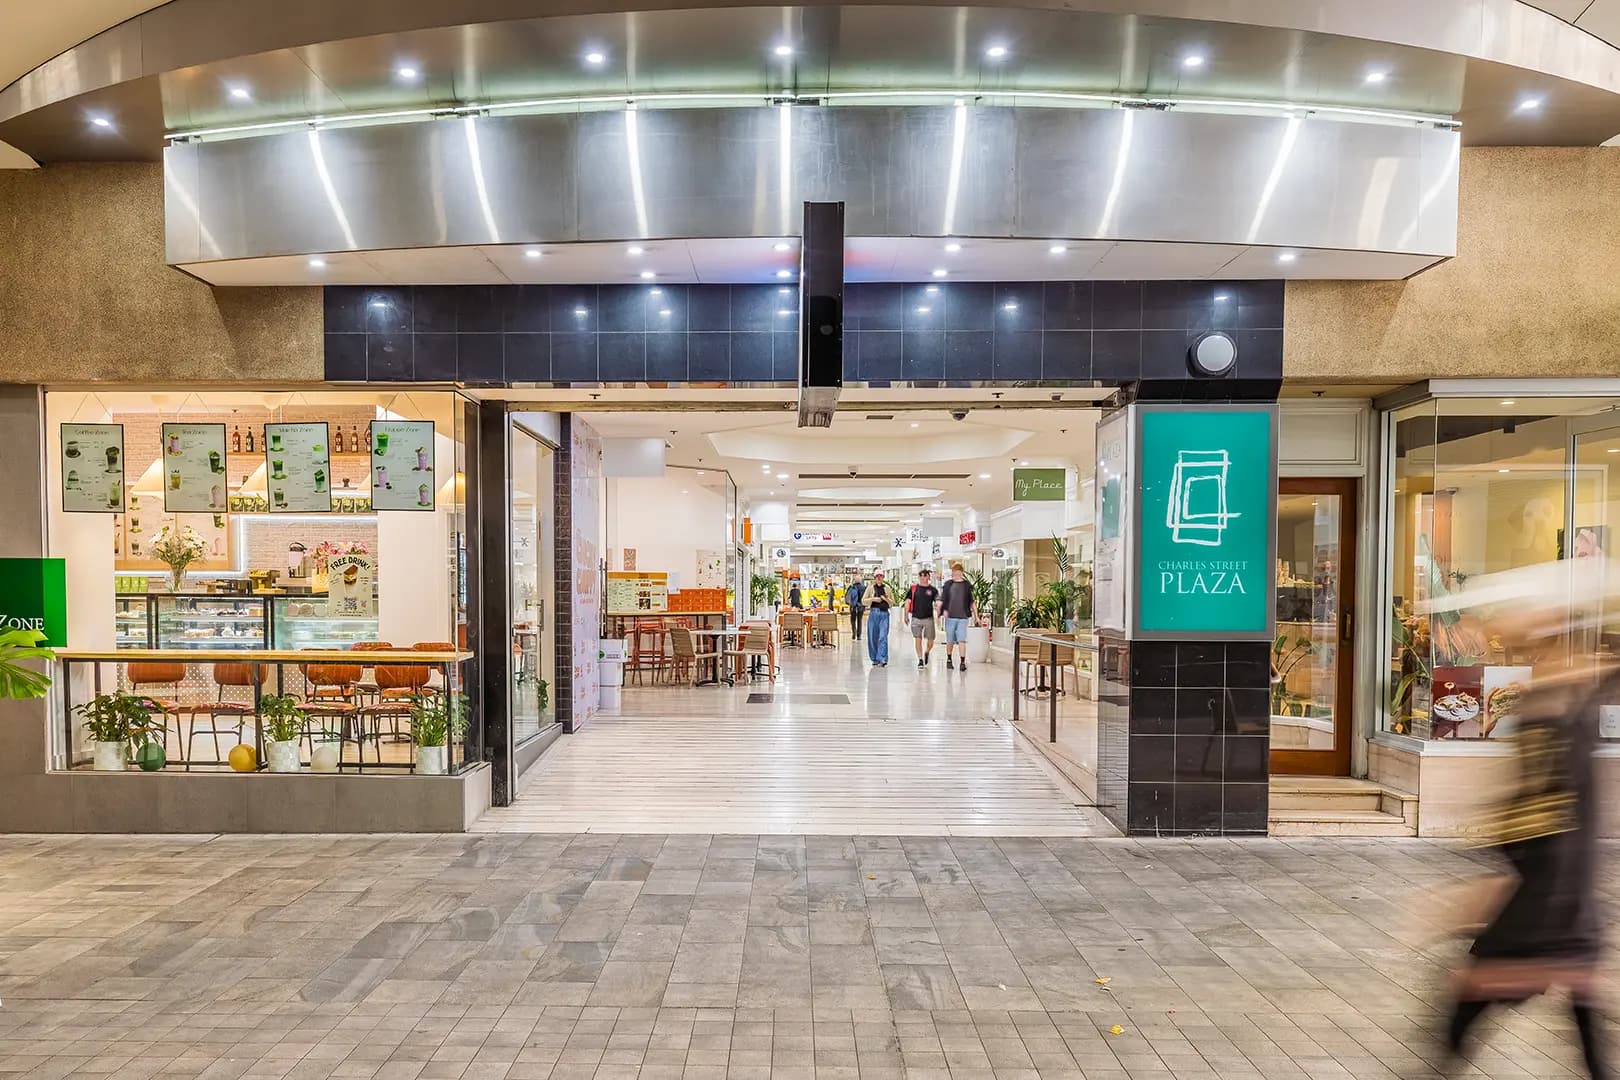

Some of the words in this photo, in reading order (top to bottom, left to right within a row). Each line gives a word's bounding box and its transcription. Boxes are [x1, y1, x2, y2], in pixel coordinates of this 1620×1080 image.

[1015, 478, 1031, 497] My
[1032, 478, 1063, 489] Place
[330, 556, 347, 570] FREE
[348, 556, 371, 570] DRINK!
[1158, 560, 1207, 570] CHARLES
[1209, 560, 1248, 570] STREET
[1160, 571, 1247, 594] PLAZA
